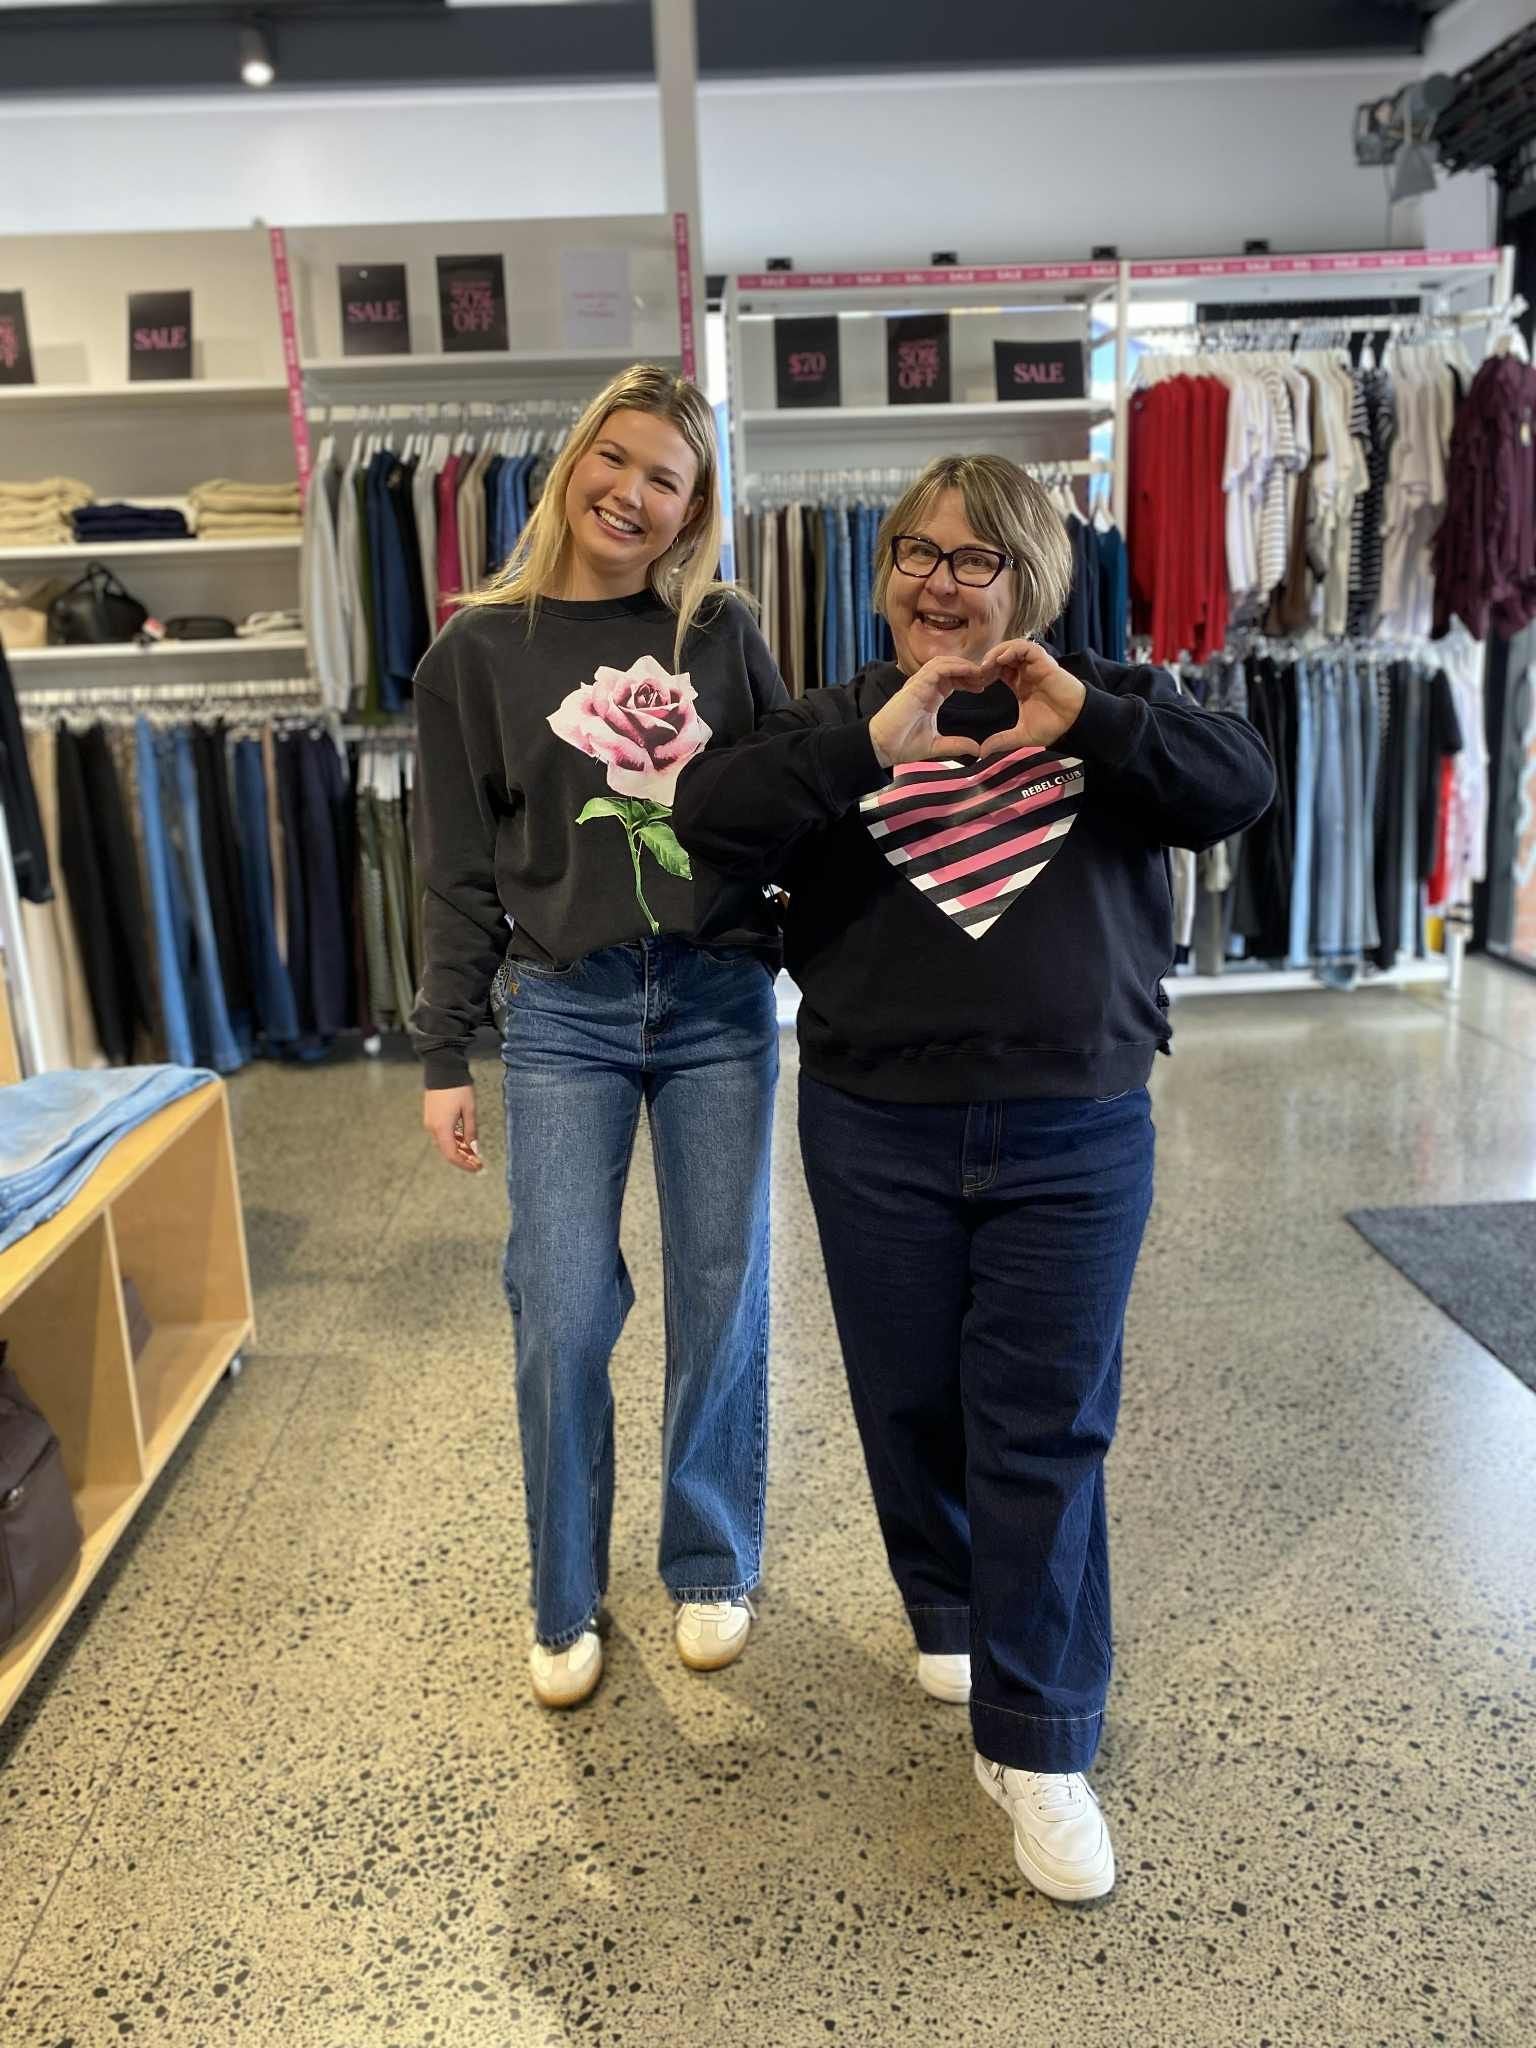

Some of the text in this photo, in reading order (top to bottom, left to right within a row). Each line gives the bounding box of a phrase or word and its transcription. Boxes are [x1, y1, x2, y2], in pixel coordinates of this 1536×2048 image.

[905, 273, 926, 283] SAL
[451, 287, 495, 310] 50%
[347, 300, 402, 322] SALE
[452, 311, 495, 332] OFF
[133, 326, 187, 350] SALE
[788, 352, 827, 375] $70
[898, 346, 938, 368] 50%
[898, 368, 938, 389] OFF
[1013, 361, 1065, 384] SALE
[1021, 770, 1082, 799] REBEL CLUB
